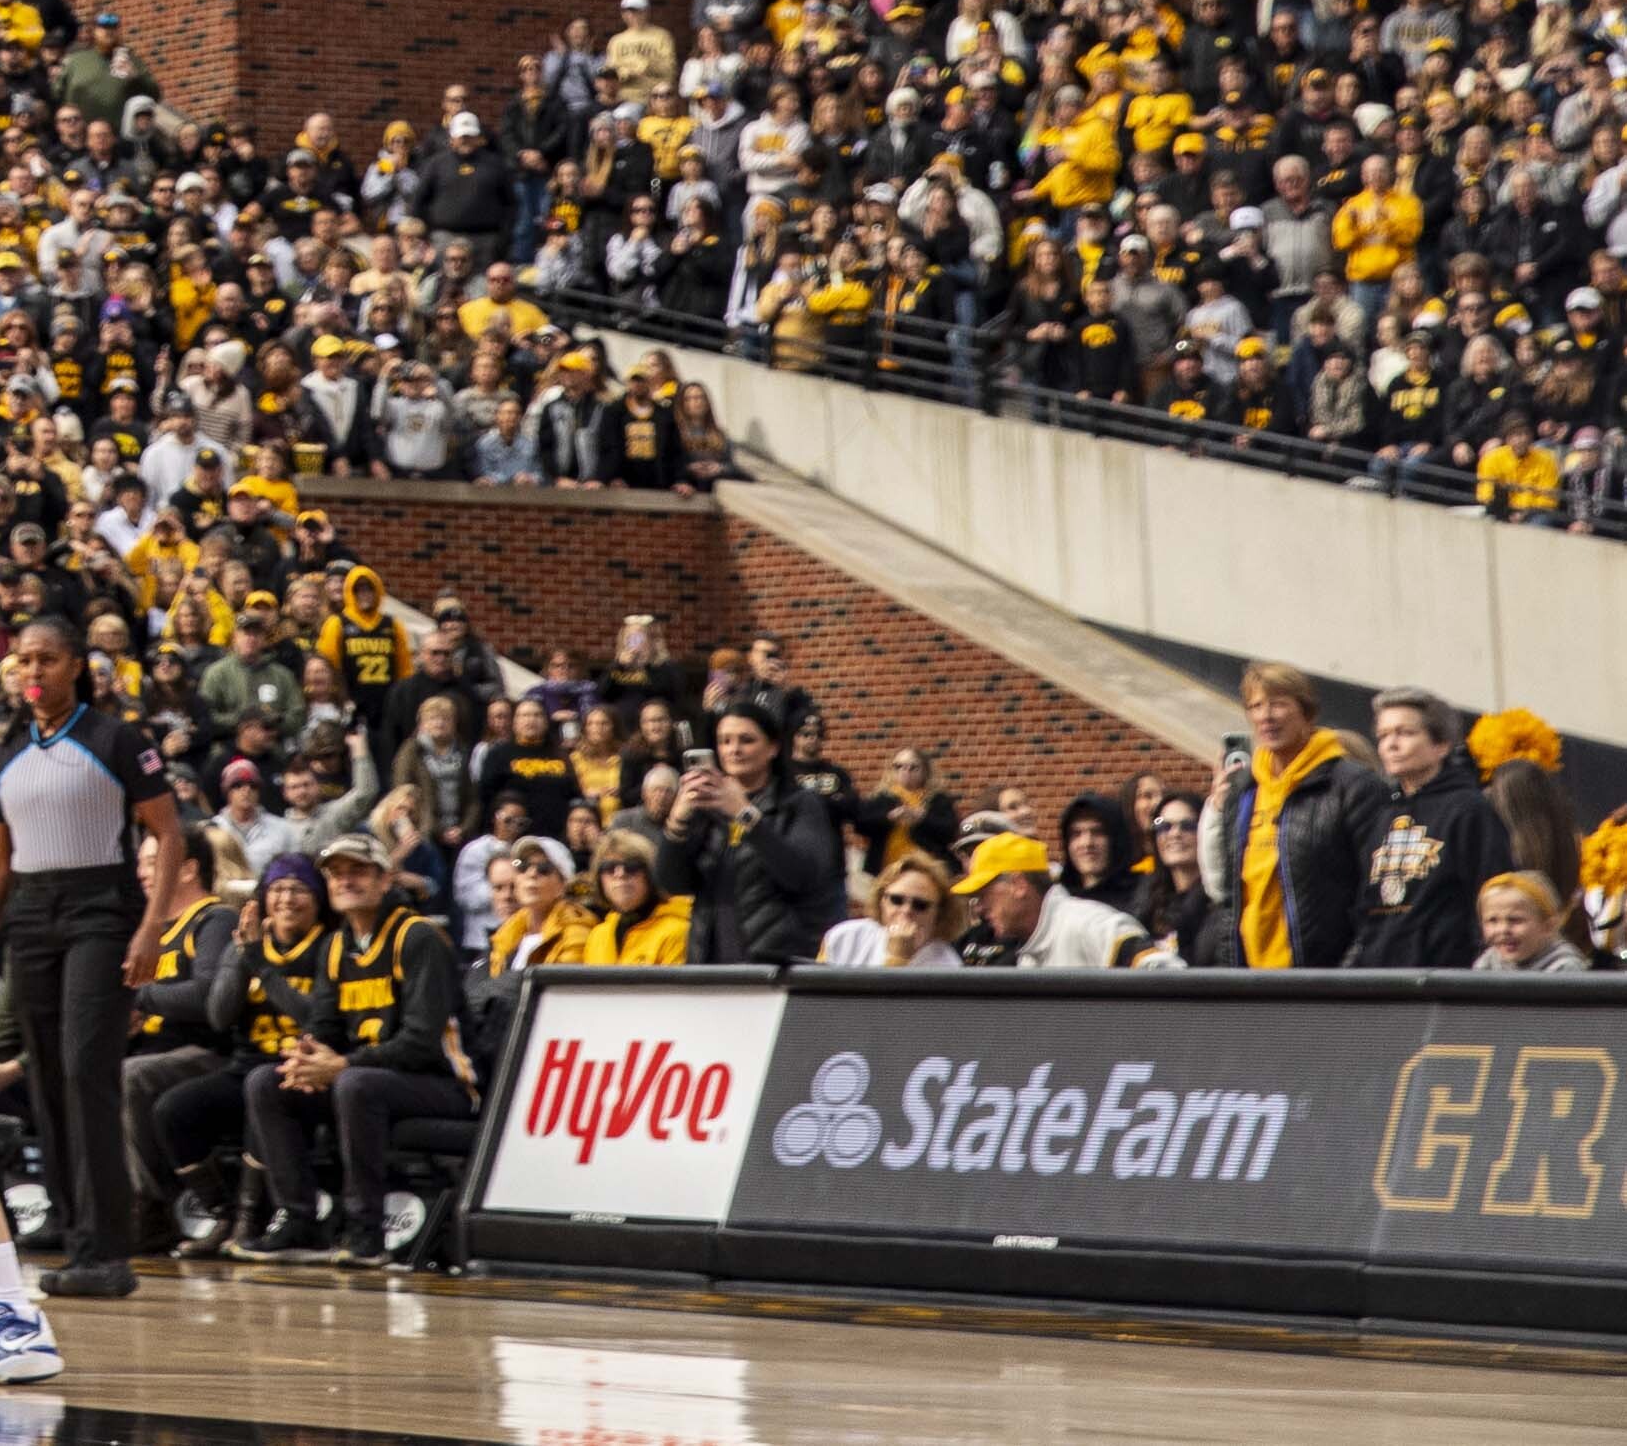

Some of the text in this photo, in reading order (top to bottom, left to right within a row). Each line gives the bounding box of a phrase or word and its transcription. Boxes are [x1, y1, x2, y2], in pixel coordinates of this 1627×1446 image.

[356, 654, 392, 684] 22
[526, 1038, 731, 1165] HyVee
[1372, 1043, 1627, 1220] CR
